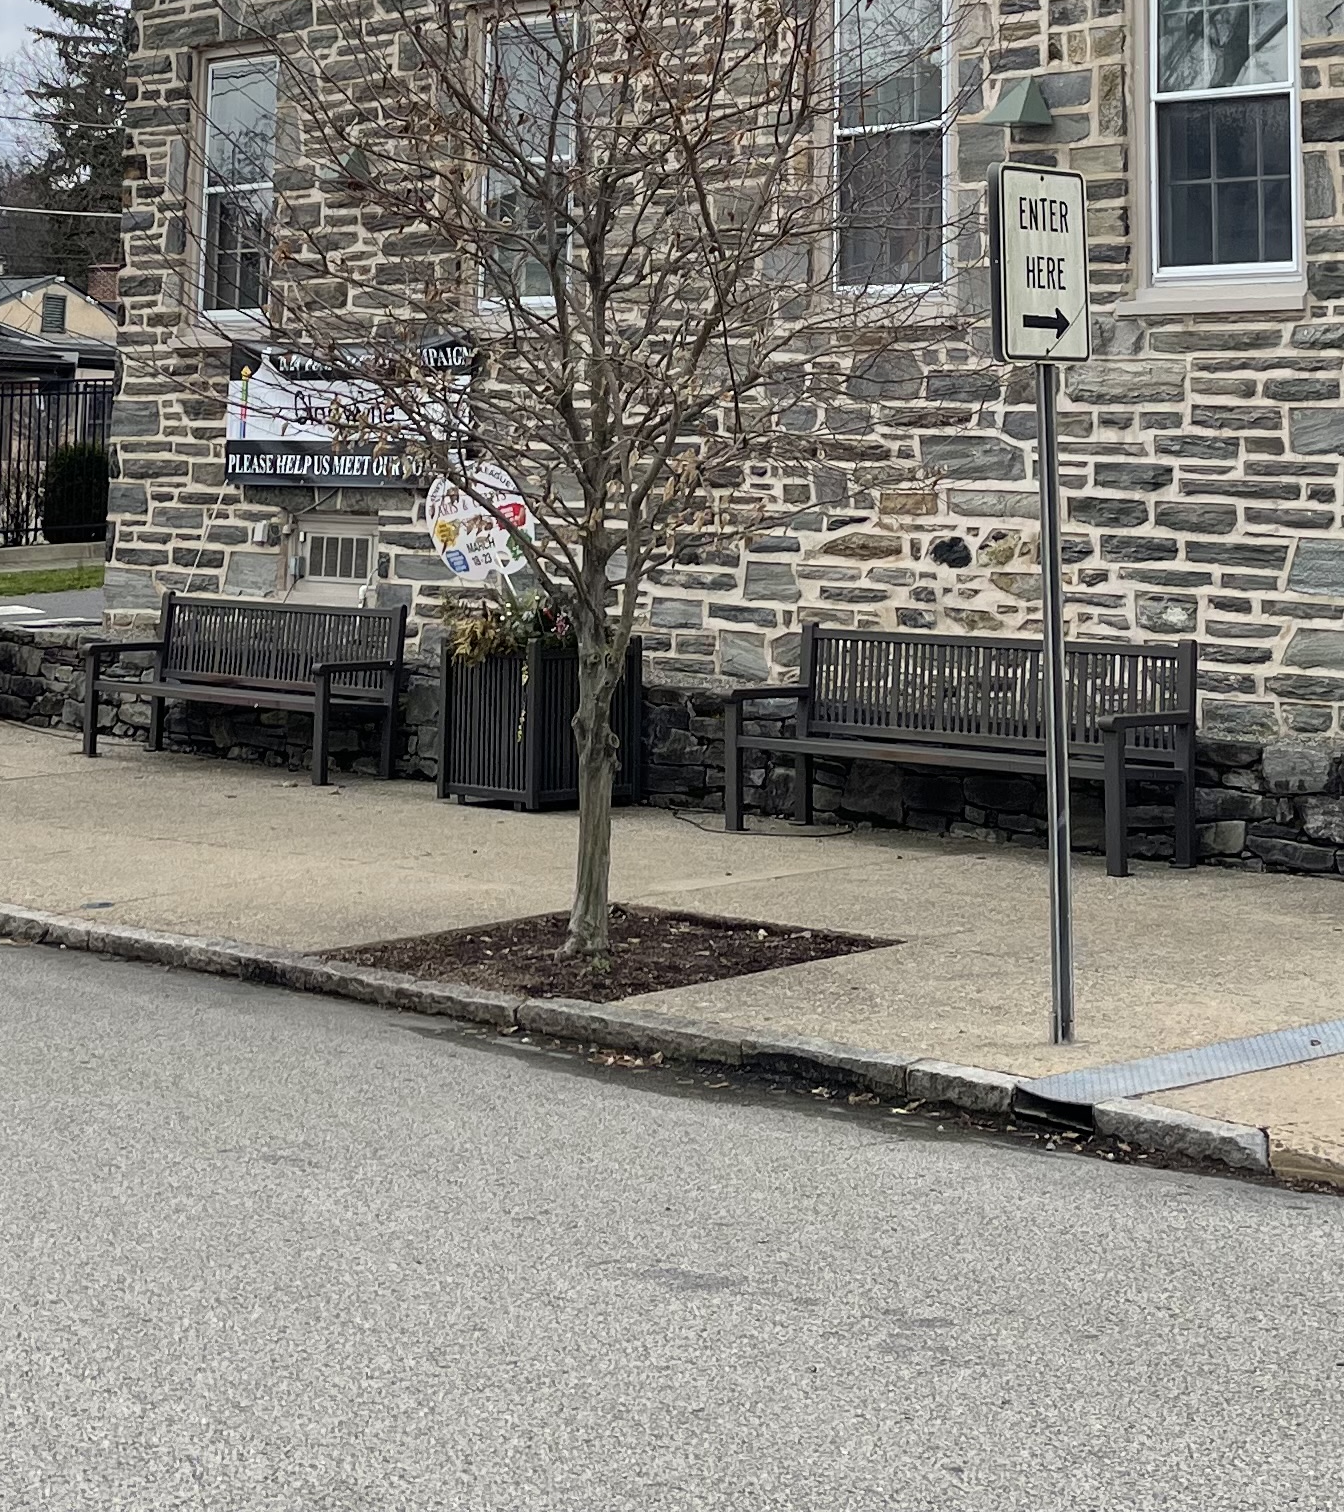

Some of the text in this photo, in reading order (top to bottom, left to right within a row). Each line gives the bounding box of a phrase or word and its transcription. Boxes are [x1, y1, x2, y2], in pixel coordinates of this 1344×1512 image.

[1019, 196, 1069, 234] ENTER
[1026, 255, 1067, 291] HERE
[227, 453, 274, 474] PLEASE
[275, 454, 312, 476] HELP
[313, 455, 330, 476] US
[331, 455, 371, 476] MEET
